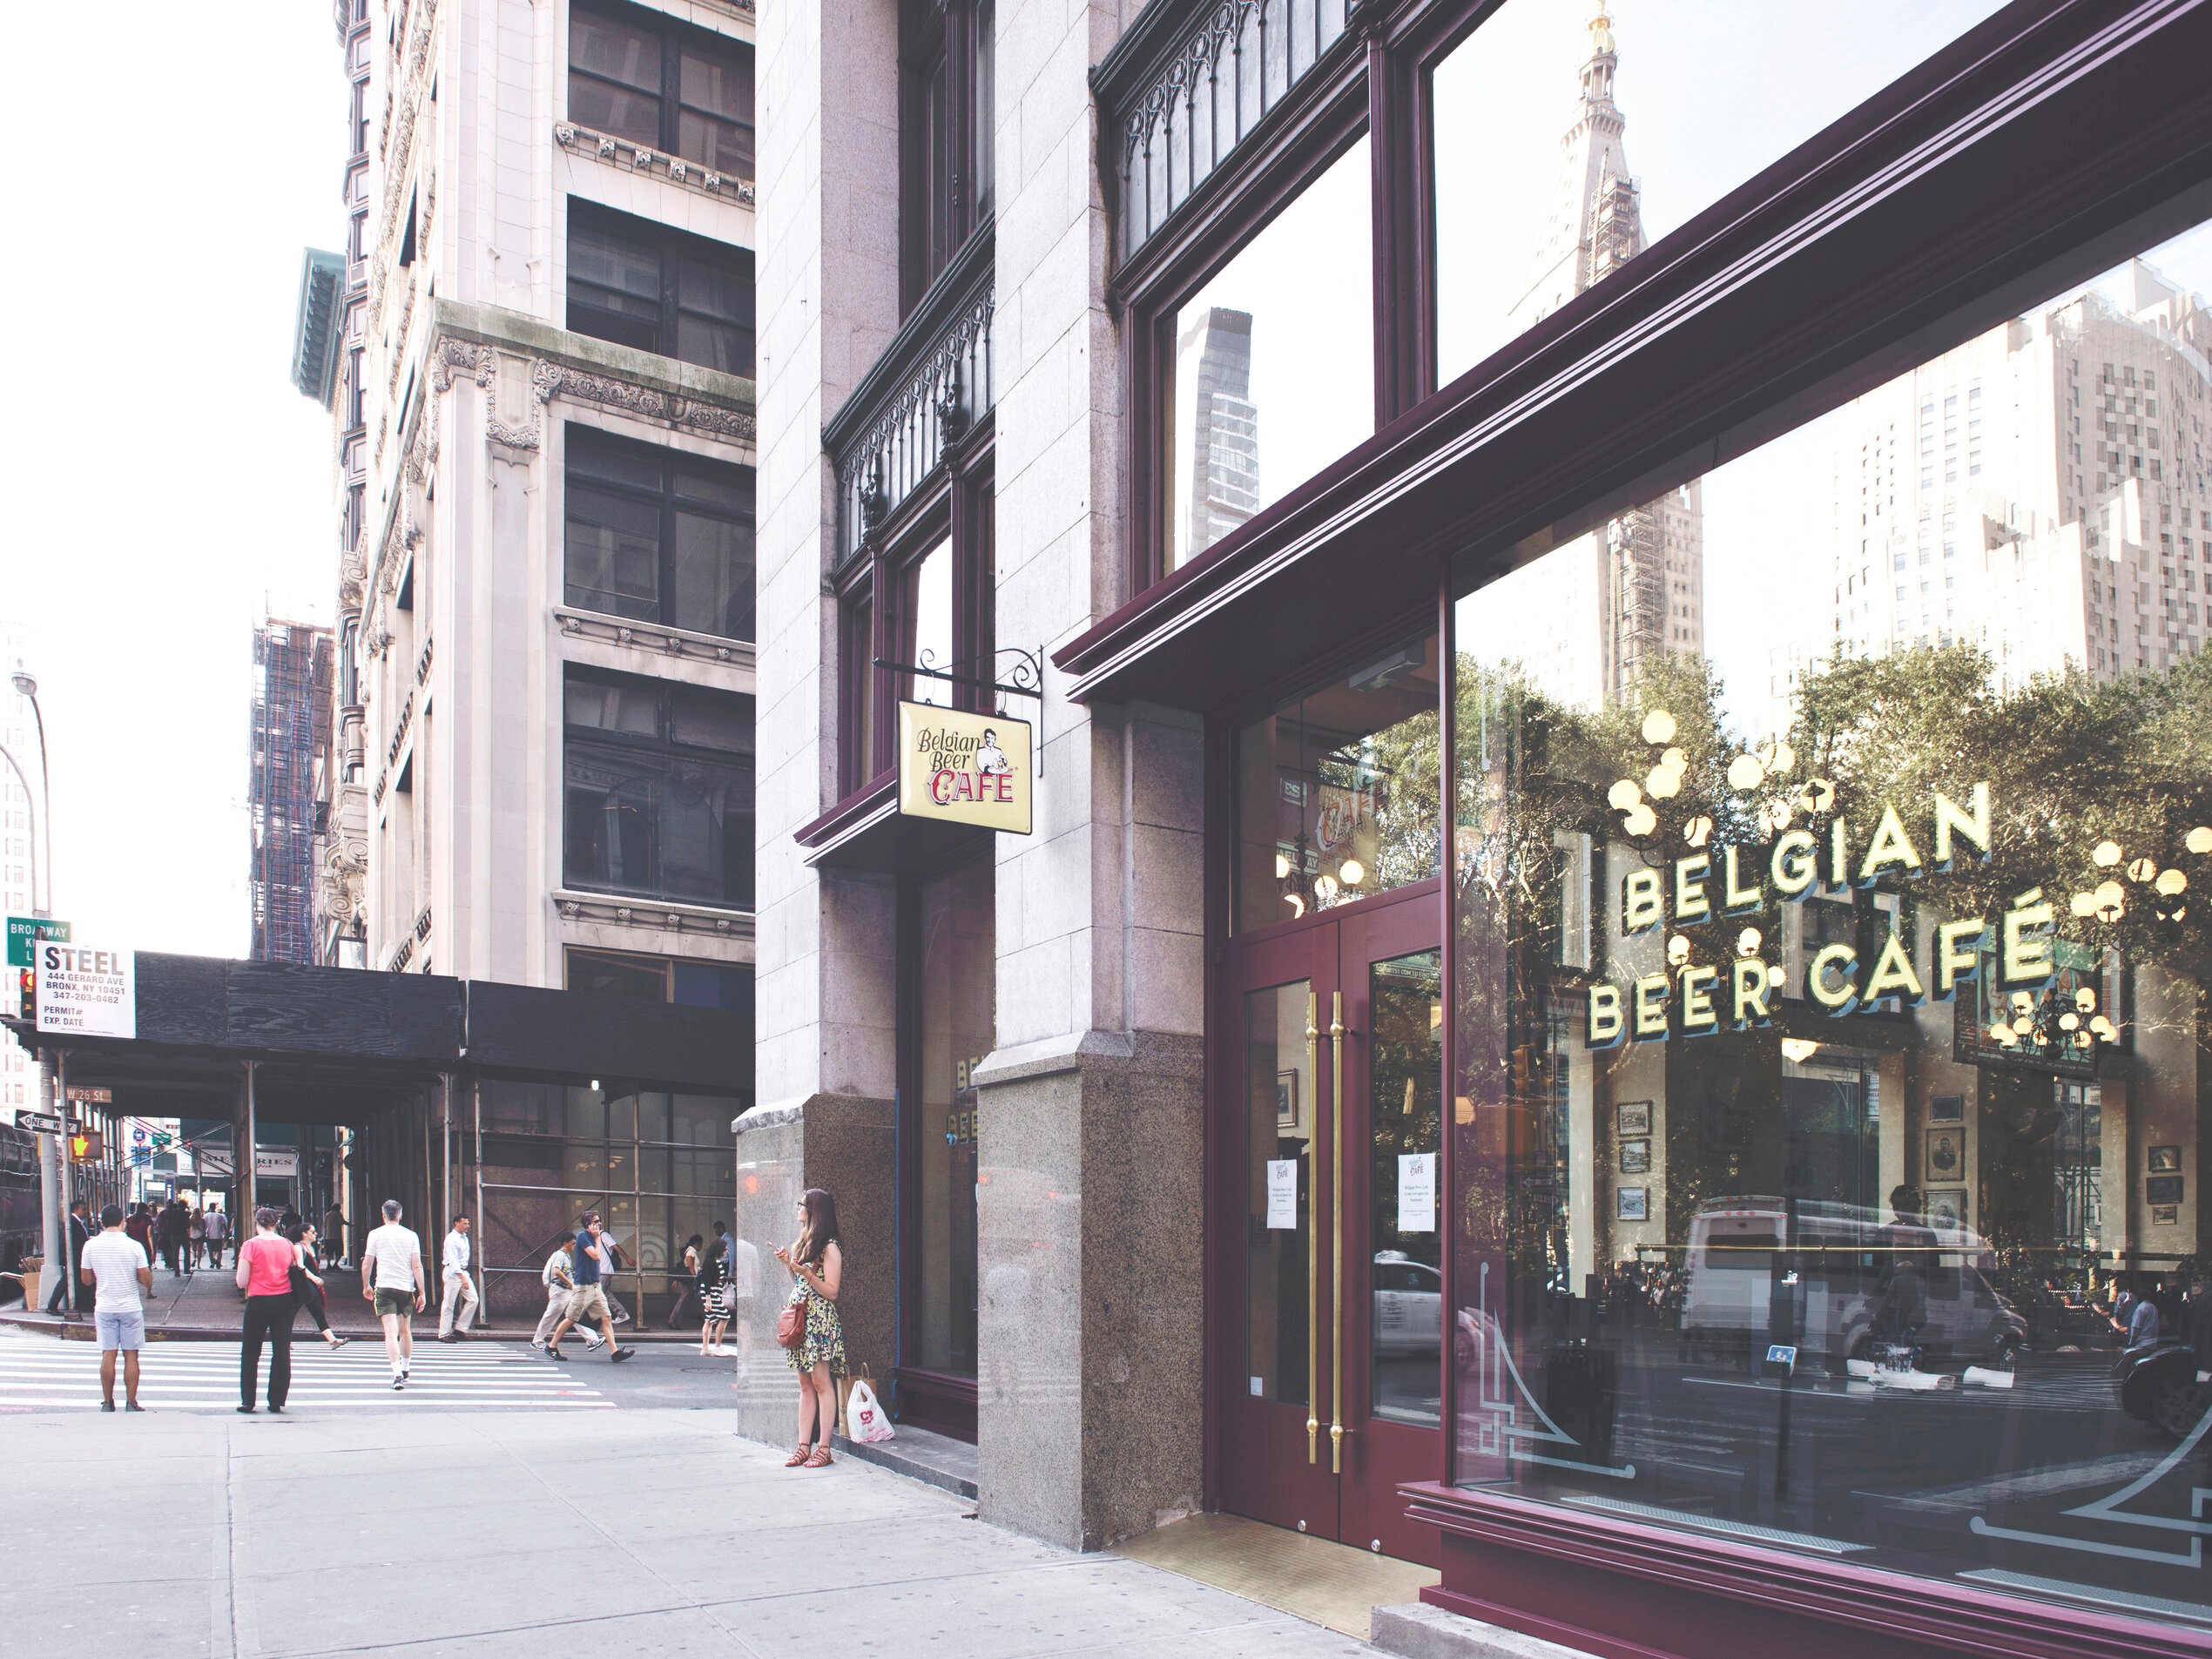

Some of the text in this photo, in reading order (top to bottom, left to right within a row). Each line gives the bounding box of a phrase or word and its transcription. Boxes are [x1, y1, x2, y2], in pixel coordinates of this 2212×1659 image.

[917, 727, 981, 756] Belgian
[929, 751, 970, 772] Beer
[1623, 781, 1992, 934] BELGIAN
[45, 946, 125, 976] STEEL
[1587, 887, 2056, 1048] BEER CAFÉ
[47, 972, 125, 986] 444 GERARD AVE
[46, 981, 125, 995] BRONX, NY 10451
[53, 991, 119, 1004] 347-203-0482
[44, 1006, 83, 1015] PERMIT#
[44, 1016, 84, 1027] EXP. DATE
[66, 1089, 104, 1101] W 26 St
[25, 1116, 73, 1130] ONE WY
